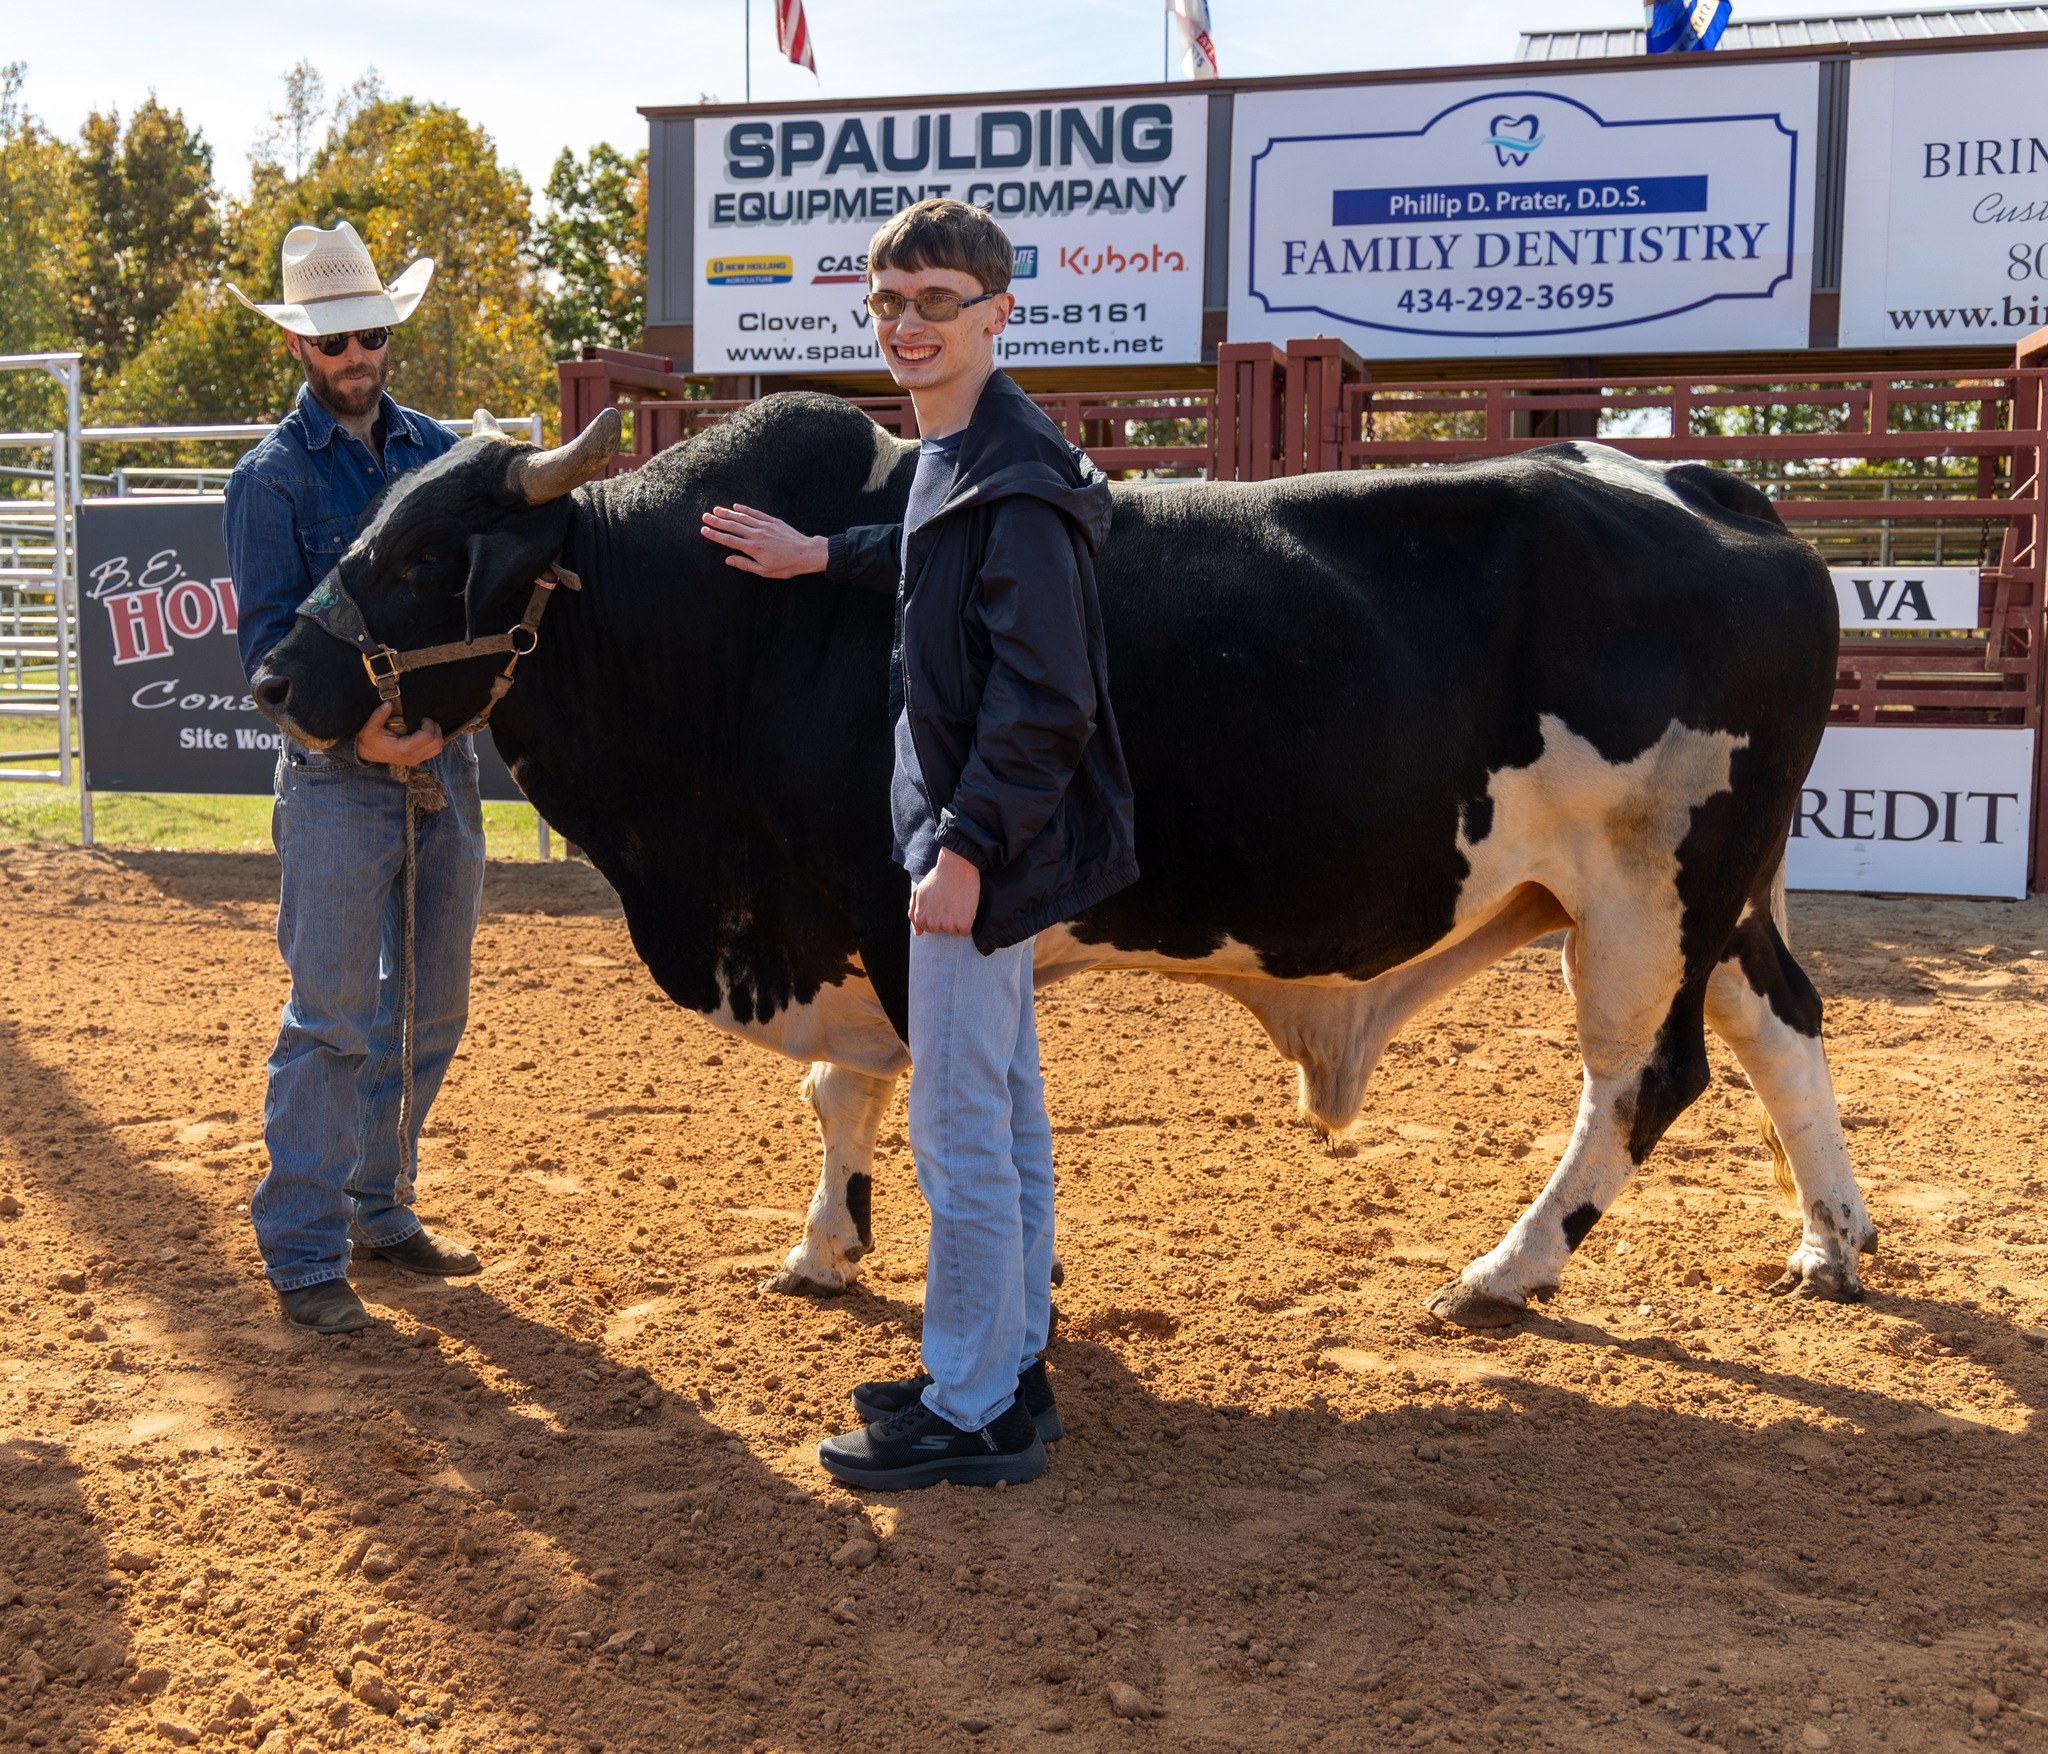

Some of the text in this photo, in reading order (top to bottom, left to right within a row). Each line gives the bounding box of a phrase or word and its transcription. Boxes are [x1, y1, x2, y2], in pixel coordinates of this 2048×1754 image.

[727, 103, 1174, 180] SPAULDING
[1922, 137, 2048, 179] BIRIN
[967, 175, 1188, 215] COMPANY
[1389, 186, 1647, 218] Phillip D. Prater, D.D.S.
[1060, 243, 1184, 275] Kubota
[1281, 222, 1770, 276] FAMILY DENTISTRY
[725, 261, 787, 271] NEW HOLLAND
[725, 276, 774, 284] AGRICULTURE
[1397, 283, 1615, 313] 434-292-3695
[1887, 295, 2048, 330] www.bi
[738, 310, 874, 334] Clover, V
[993, 335, 1164, 360] ipment.net
[86, 549, 187, 600] B.E.
[1852, 579, 1937, 622] VA
[131, 678, 259, 711] Cons
[179, 727, 229, 750] Site
[1787, 787, 2019, 845] REDIT
